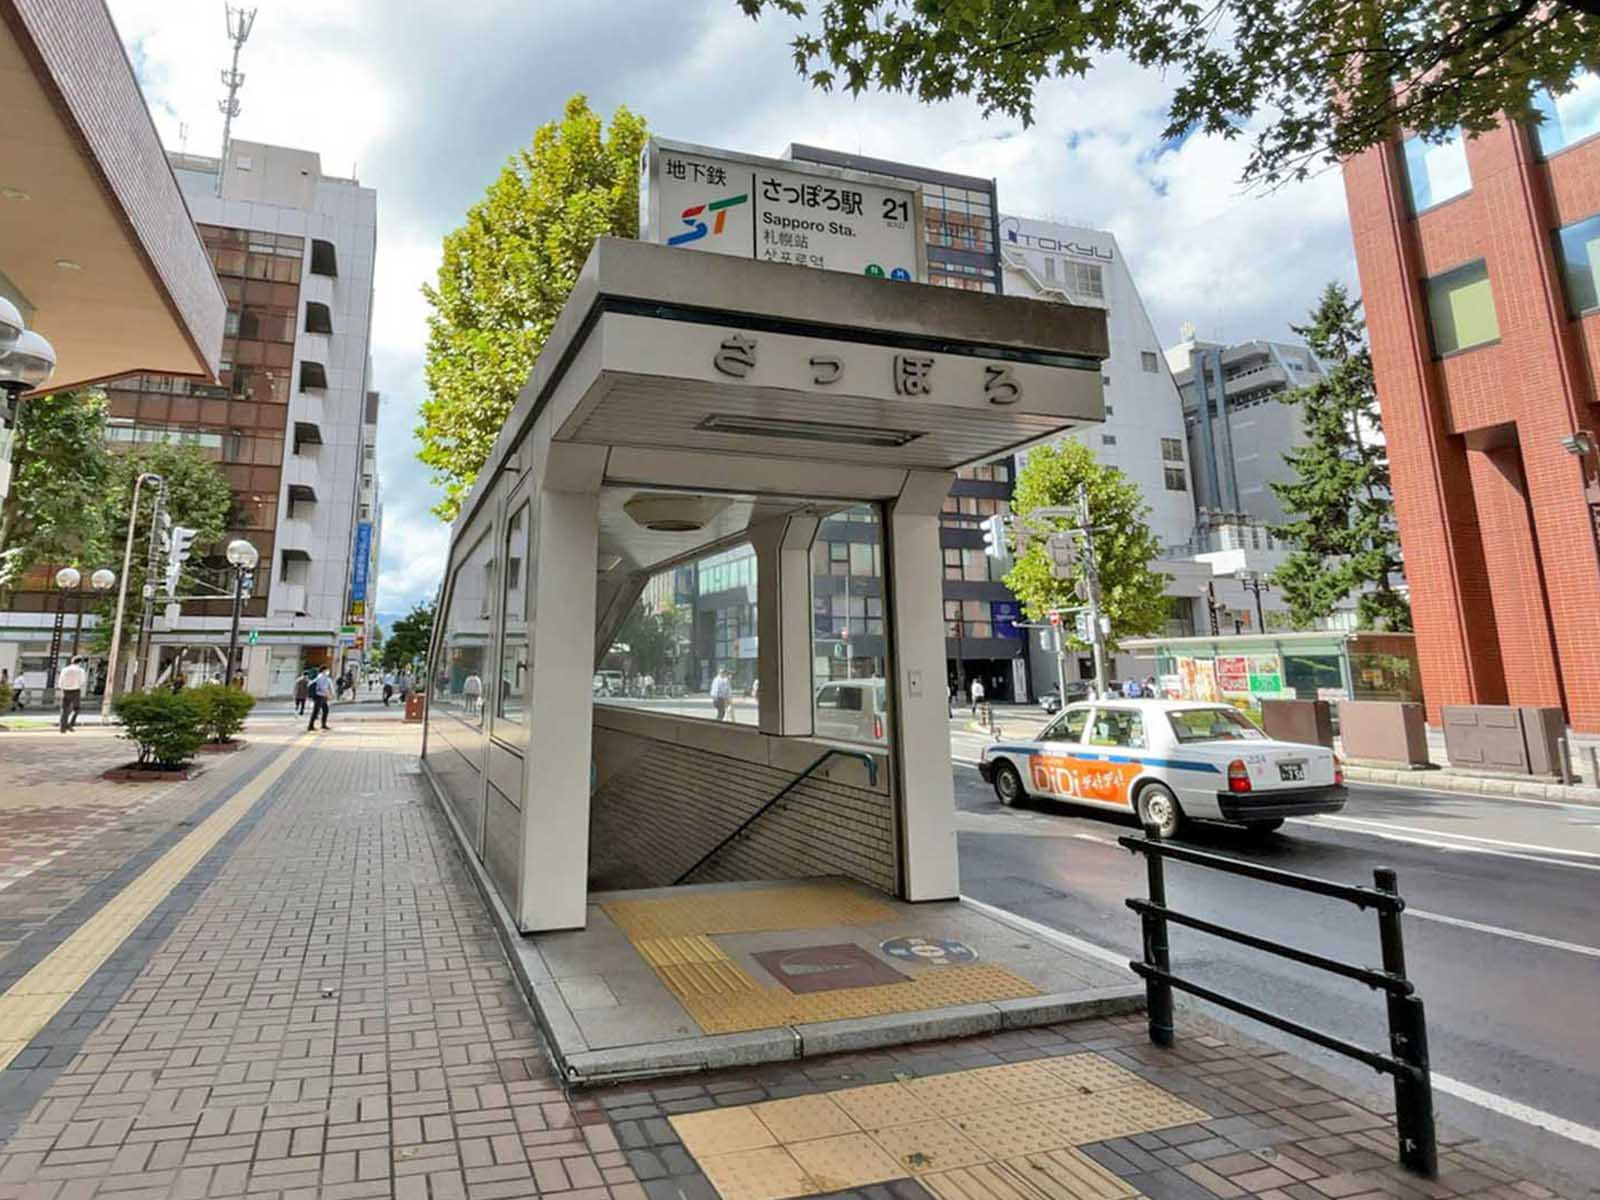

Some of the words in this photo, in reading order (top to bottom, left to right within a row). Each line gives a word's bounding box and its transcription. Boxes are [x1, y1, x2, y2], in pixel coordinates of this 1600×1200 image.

[666, 158, 728, 188] 地下鉄
[762, 178, 864, 216] さっぽろ駅
[882, 197, 909, 222] 21
[763, 211, 825, 232] Sapporo
[829, 221, 857, 238] Sta.
[1018, 233, 1114, 261] TOKYU
[1034, 764, 1082, 799] DiDi
